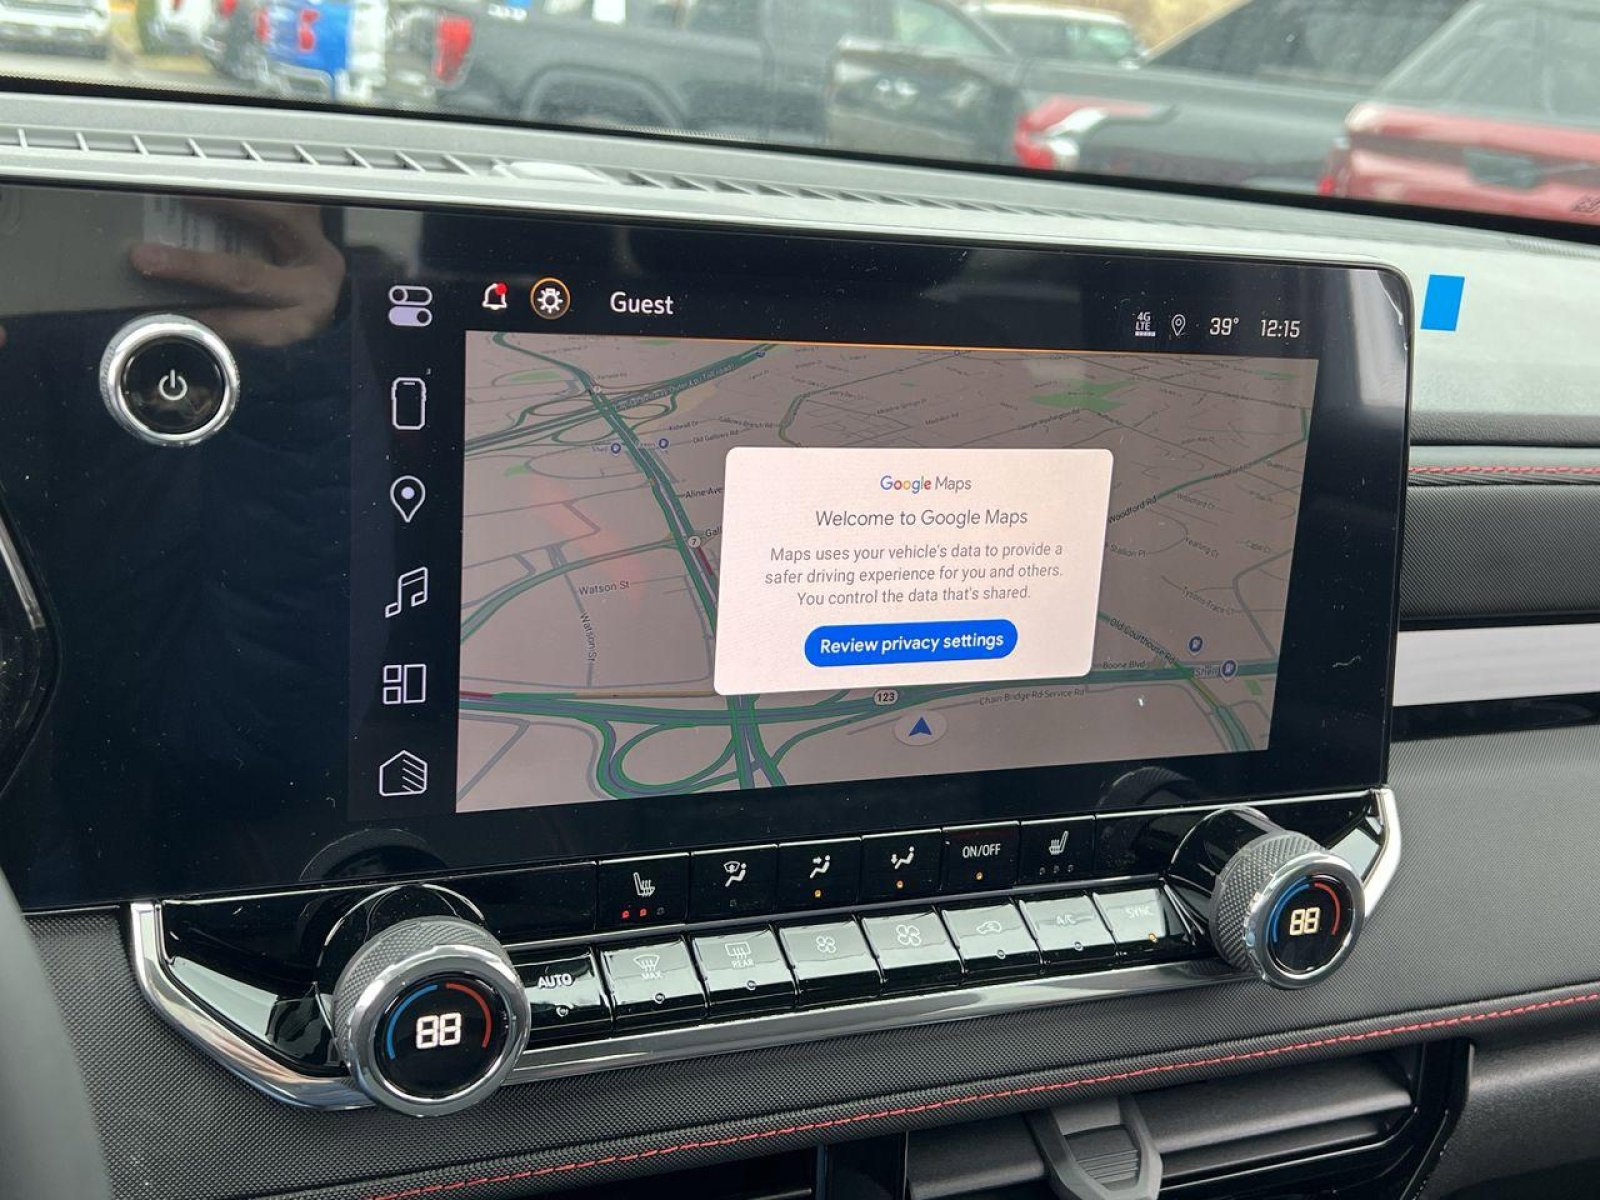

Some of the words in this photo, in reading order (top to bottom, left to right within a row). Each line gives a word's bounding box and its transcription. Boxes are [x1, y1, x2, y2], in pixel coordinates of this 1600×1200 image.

[609, 291, 674, 315] Guest
[1135, 322, 1151, 331] LTE
[1136, 312, 1151, 322] 4G
[1209, 316, 1240, 336] 39°
[1260, 319, 1301, 338] 12:15
[879, 475, 932, 494] Google
[934, 476, 972, 493] Maps
[1108, 501, 1145, 523] Woodford
[1146, 494, 1157, 506] Rd
[815, 510, 894, 526] Welcome
[899, 511, 916, 526] to
[920, 509, 981, 529] Google
[985, 509, 1029, 527] Maps
[770, 548, 811, 563] Maps
[815, 550, 850, 561] uses
[853, 549, 885, 563] your
[888, 543, 947, 559] vehicle's
[950, 544, 981, 558] data
[985, 545, 999, 557] to
[1002, 542, 1051, 559] provide
[1054, 545, 1063, 555] a
[765, 569, 803, 584] safer
[806, 569, 855, 585] driving
[859, 567, 935, 584] experience
[939, 566, 959, 579] for
[961, 568, 986, 582] you
[989, 564, 1014, 578] and
[1018, 564, 1064, 577] others.
[579, 582, 618, 596] Watson
[618, 580, 630, 590] St
[797, 592, 825, 606] You
[828, 589, 878, 605] control
[881, 589, 904, 603] the
[908, 588, 938, 602] data
[942, 586, 979, 600] that's
[983, 585, 1031, 599] shared.
[580, 612, 596, 650] Watson
[820, 637, 878, 655] Review
[881, 635, 940, 655] privacy
[943, 632, 1005, 651] settings
[1109, 618, 1124, 631] Old
[1123, 625, 1165, 657] Courthouse
[1164, 651, 1176, 665] Rd
[587, 650, 598, 662] St
[877, 692, 895, 703] 123
[1043, 689, 1072, 698] Service
[1074, 687, 1085, 696] Rd
[962, 843, 1001, 858] ON/OFF
[1289, 906, 1321, 936] 88
[537, 972, 573, 988] AUTO
[416, 1012, 462, 1049] 88
